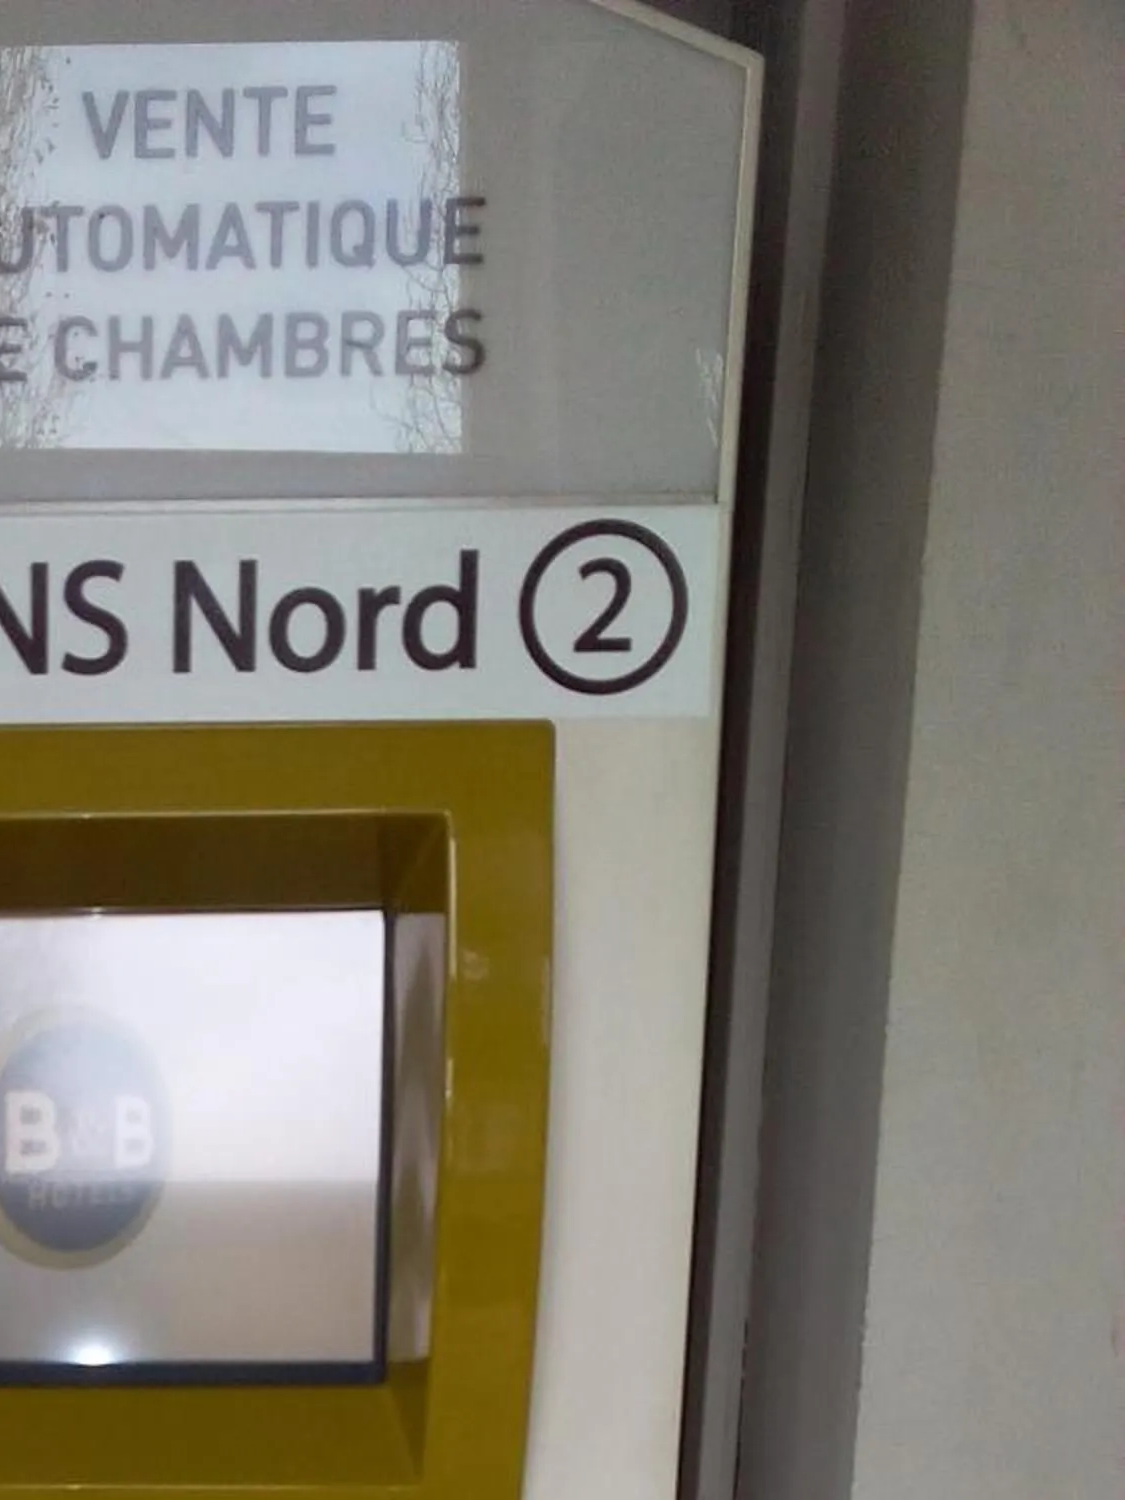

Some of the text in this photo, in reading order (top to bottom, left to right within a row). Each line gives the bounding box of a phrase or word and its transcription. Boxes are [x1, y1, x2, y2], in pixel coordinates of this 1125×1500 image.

[82, 85, 337, 160] VENTE
[54, 308, 486, 380] CHAMBRES
[172, 549, 480, 673] Nord
[573, 556, 633, 653] 2
